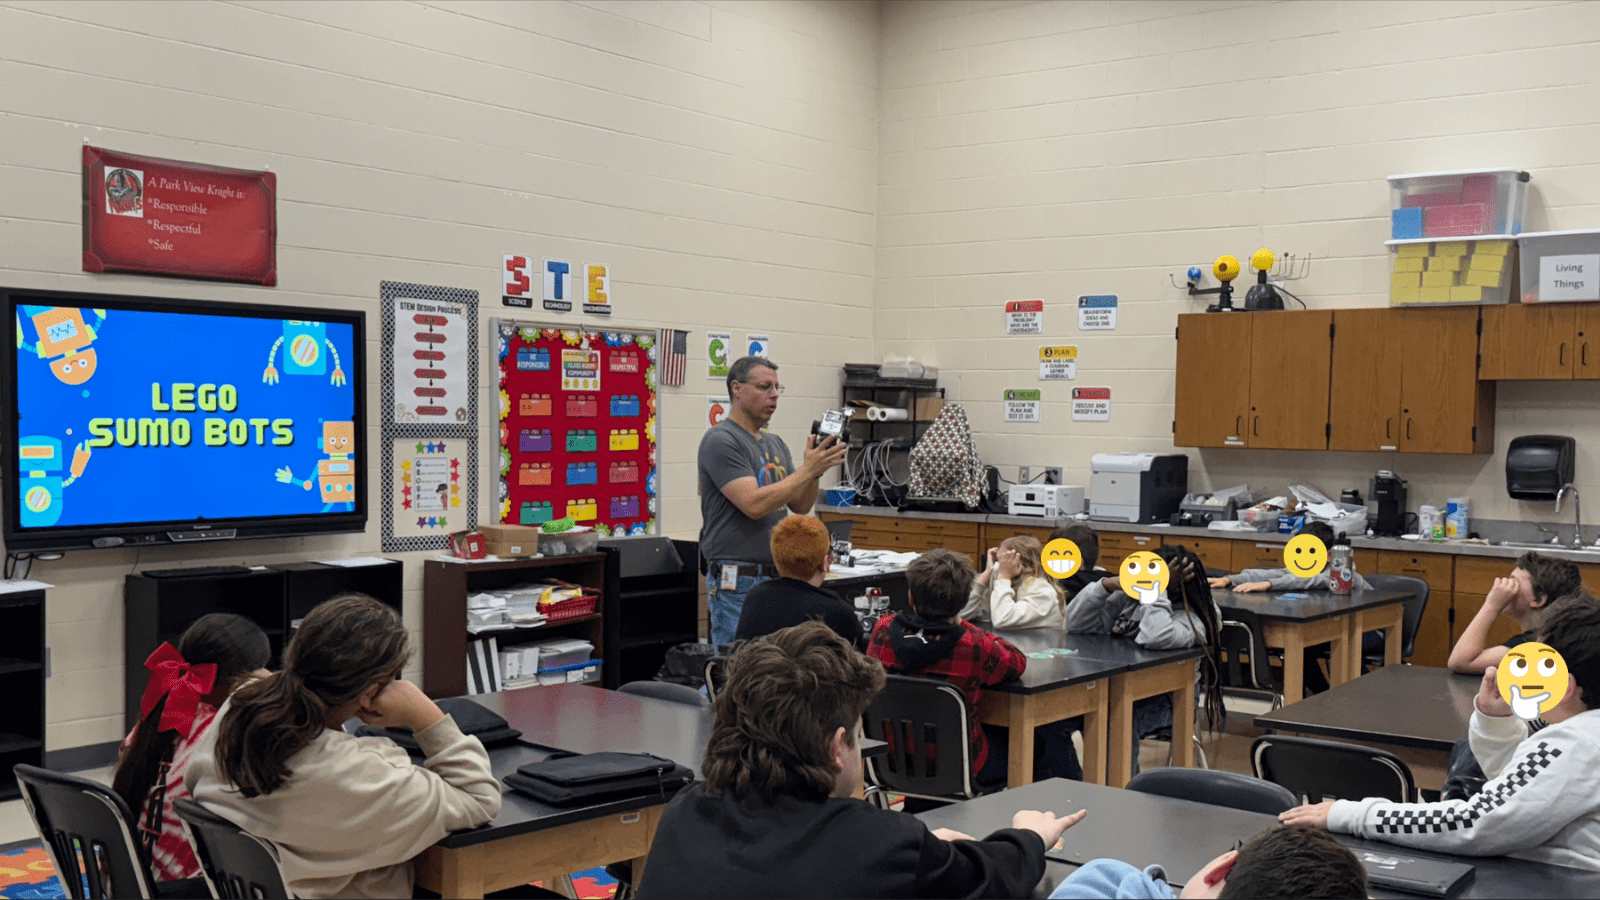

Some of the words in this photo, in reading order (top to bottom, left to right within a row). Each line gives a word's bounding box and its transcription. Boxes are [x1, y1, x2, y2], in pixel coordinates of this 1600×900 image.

[148, 177, 157, 187] A
[160, 178, 181, 192] Park
[184, 181, 204, 194] View
[207, 184, 235, 199] Knight
[236, 188, 246, 199] is:
[1556, 263, 1583, 273] Living
[506, 256, 530, 296] S
[547, 261, 569, 300] T
[588, 265, 607, 304] E
[1554, 279, 1584, 289] Things
[400, 302, 415, 310] STEM
[544, 301, 571, 310] TECHNOLOGY
[709, 339, 724, 366] C
[152, 382, 238, 412] LEGO
[710, 404, 724, 426] C
[89, 418, 191, 447] SUMO
[204, 418, 294, 446] BOTS
